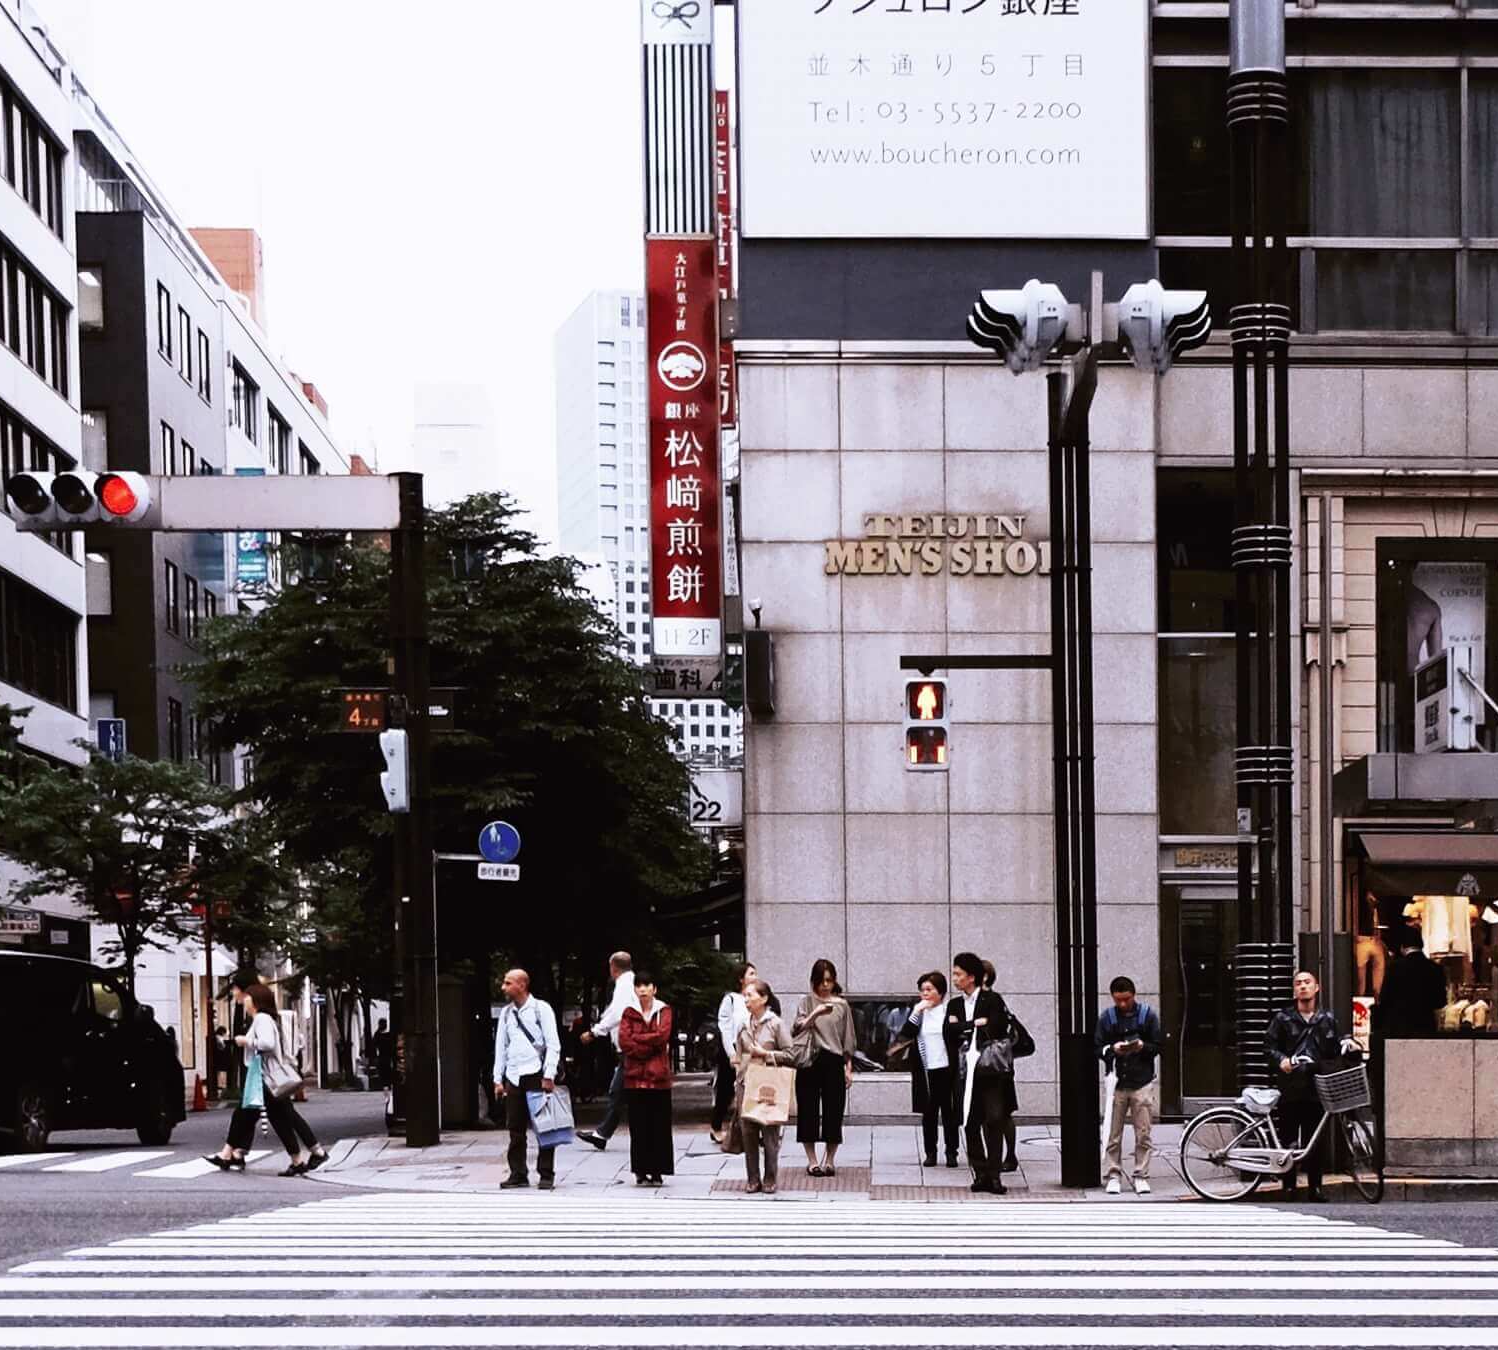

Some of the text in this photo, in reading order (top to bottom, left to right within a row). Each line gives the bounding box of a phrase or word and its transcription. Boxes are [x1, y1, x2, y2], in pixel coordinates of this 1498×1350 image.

[807, 53, 1084, 77] 並木通り5丁目
[808, 101, 865, 124] Tel:
[809, 141, 1081, 165] www.boucheron.com
[665, 402, 700, 419] 銀座
[863, 514, 1025, 539] TEIJIN
[824, 541, 945, 576] MEN'S
[688, 627, 711, 646] 2F
[654, 667, 702, 690] 歯科
[692, 801, 721, 821] 22
